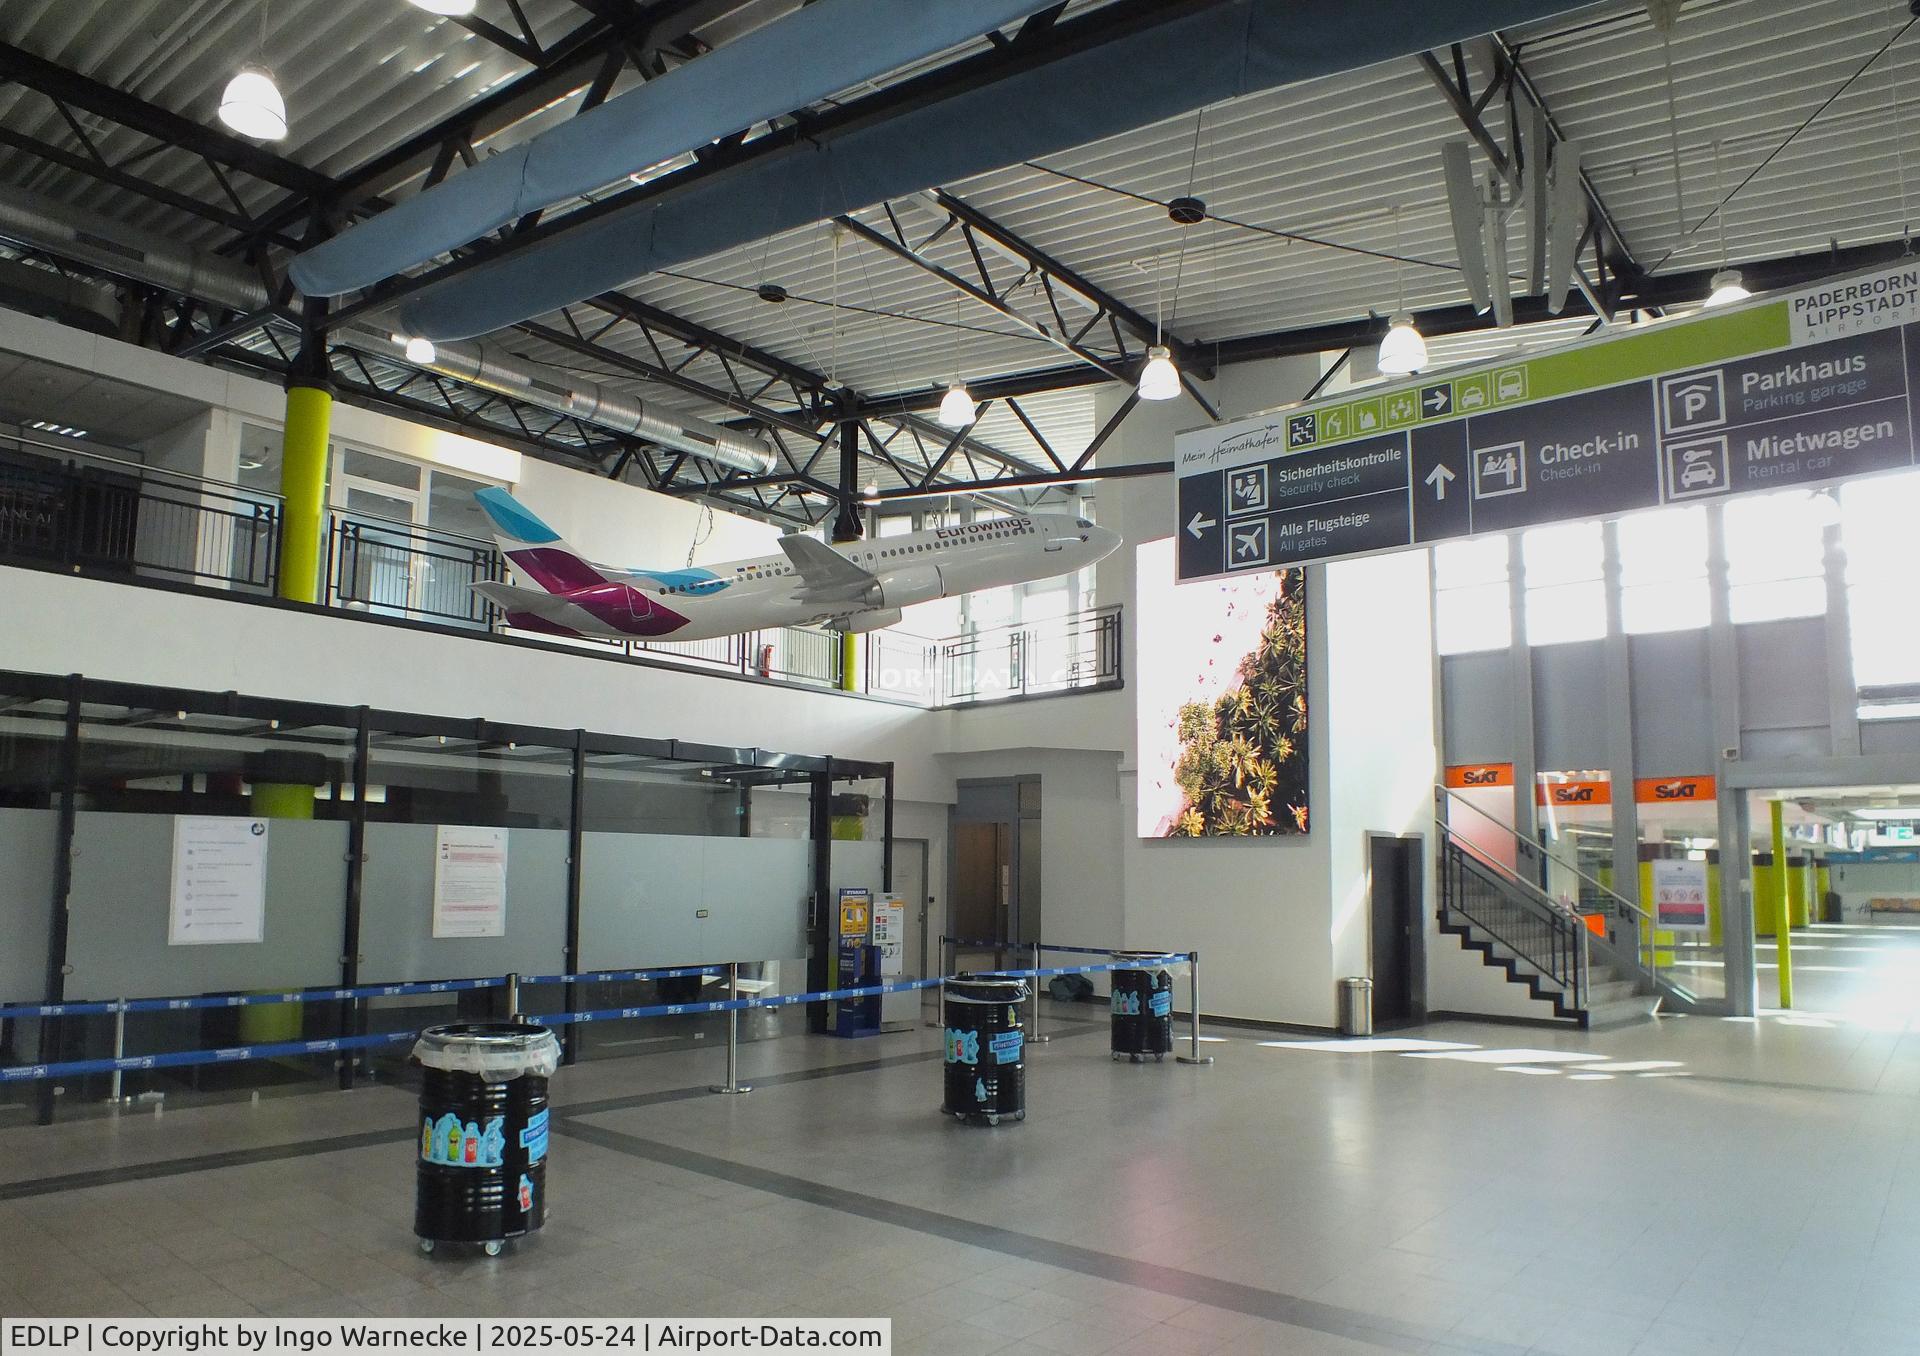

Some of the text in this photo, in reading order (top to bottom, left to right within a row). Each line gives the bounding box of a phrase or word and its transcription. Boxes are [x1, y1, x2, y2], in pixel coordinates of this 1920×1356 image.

[1794, 271, 1918, 312] PADERBORN
[1806, 289, 1918, 327] LIPPSTADT
[1808, 308, 1919, 338] AIRPORT
[1742, 354, 1866, 394] Parkhaus
[1743, 379, 1867, 411] Parking garage
[1182, 432, 1280, 464] Mein Heimathafen
[1539, 431, 1639, 465] Check-in
[1746, 420, 1894, 461] Mietwagen
[1279, 448, 1402, 483] Sicherheitskontrolle
[1540, 462, 1601, 482] Check-in
[1748, 455, 1833, 479] Rental car
[1279, 473, 1361, 497] Security check
[935, 517, 1032, 540] Eurowings
[1280, 512, 1370, 537] Alle Flugsteige
[1280, 536, 1327, 552] All gates
